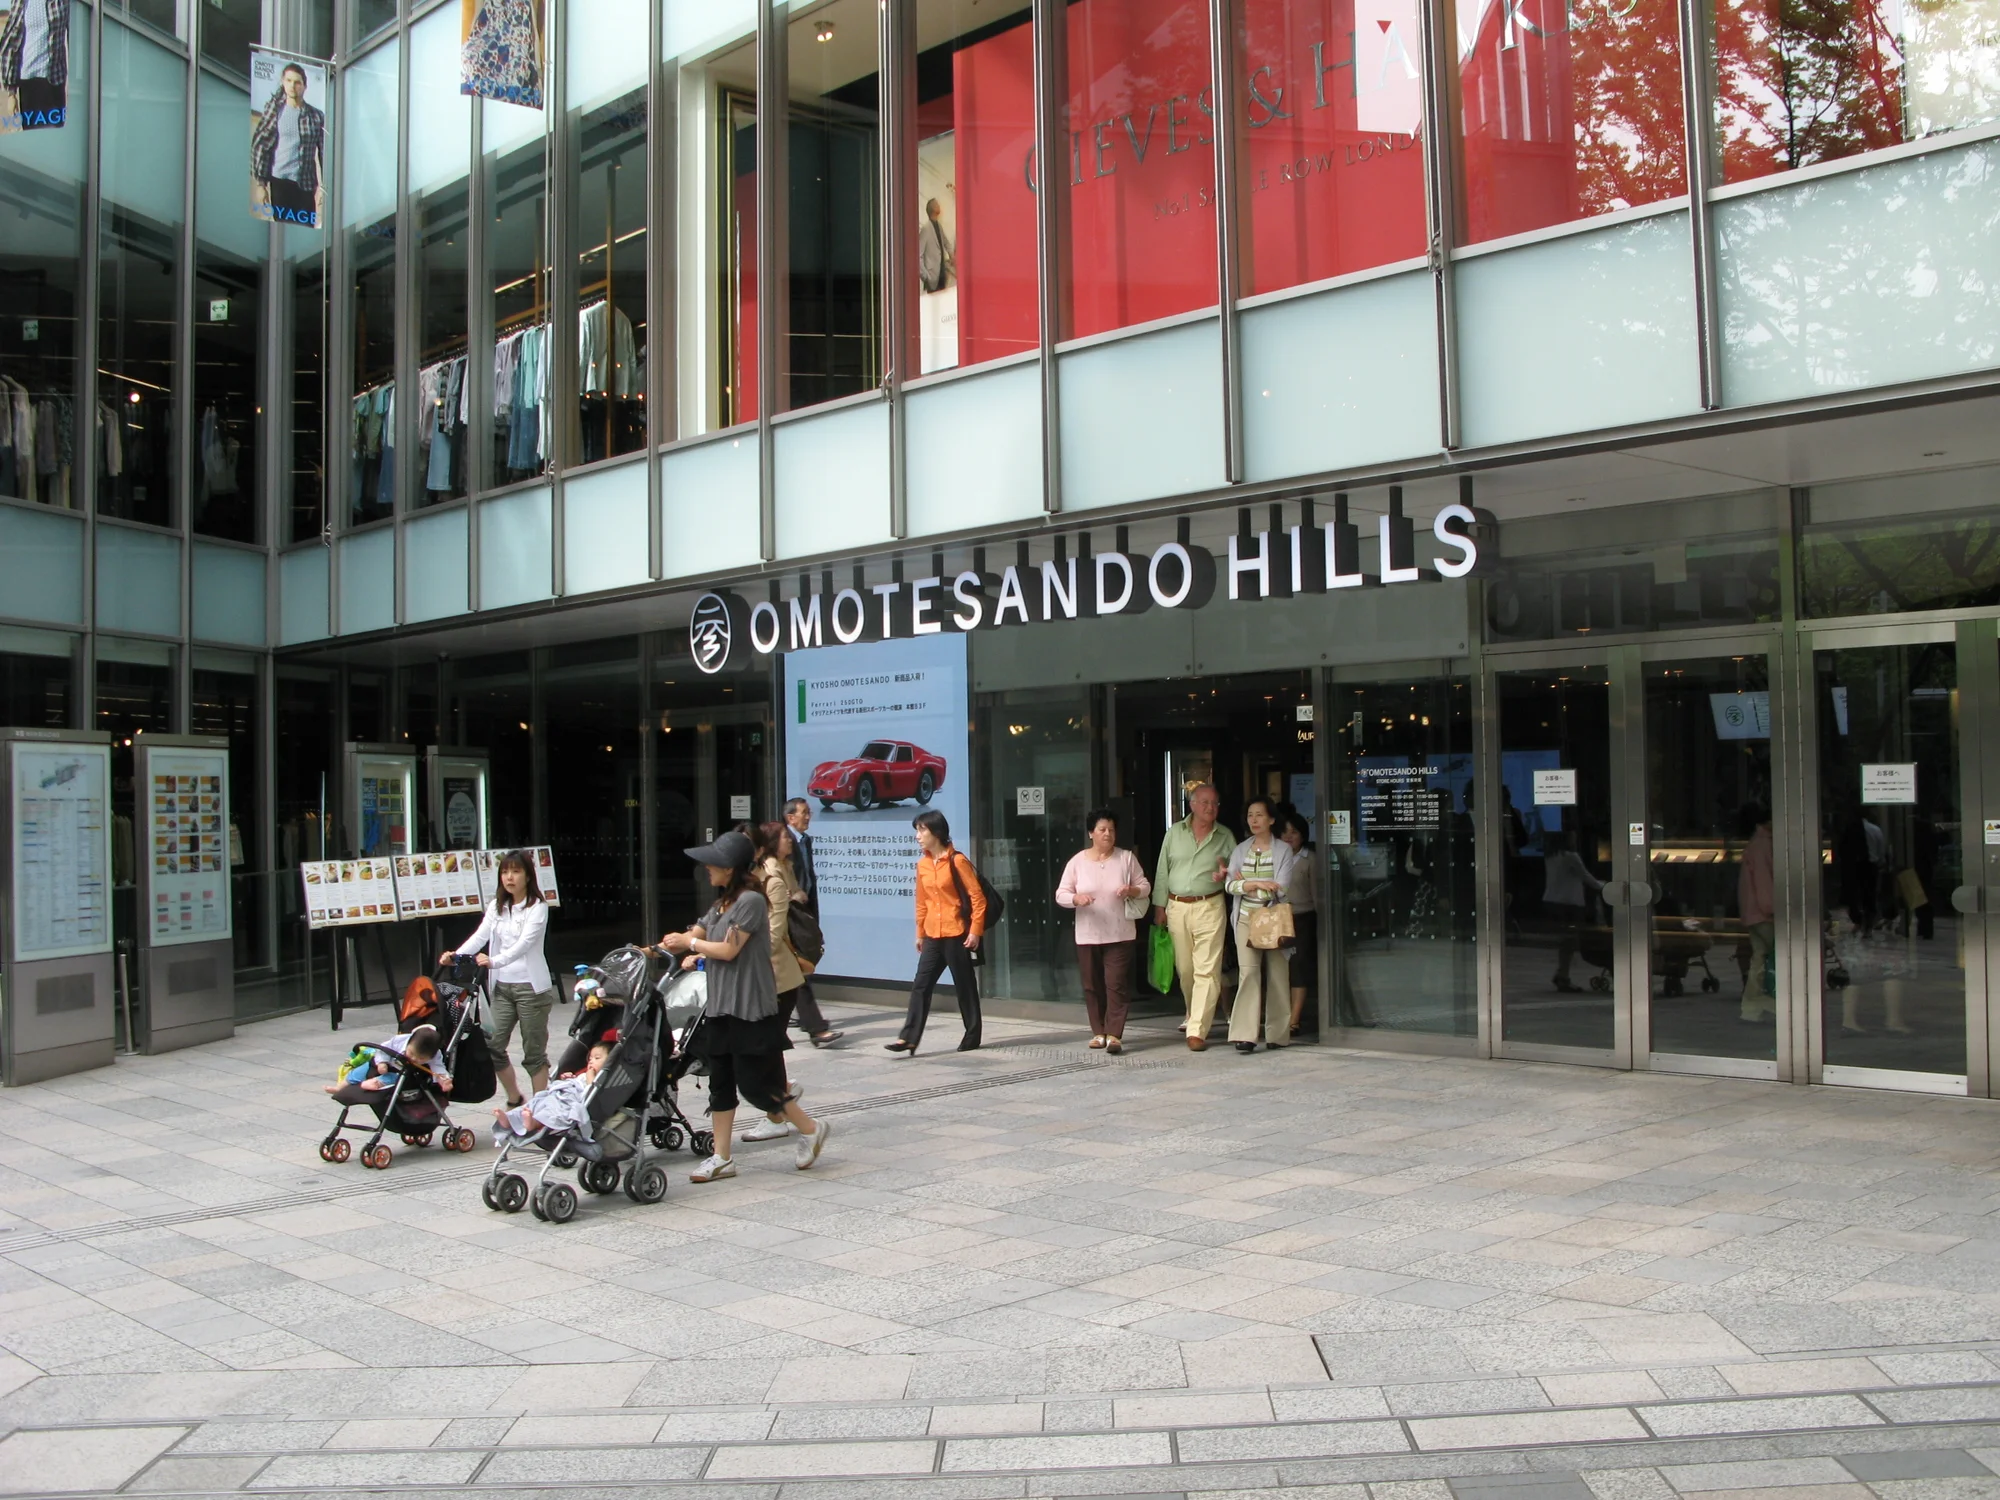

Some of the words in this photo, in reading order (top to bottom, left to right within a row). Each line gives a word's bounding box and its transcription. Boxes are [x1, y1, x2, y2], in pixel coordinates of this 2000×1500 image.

[1248, 66, 1294, 128] &
[1279, 149, 1334, 184] ROW
[1345, 126, 1424, 167] LOND
[252, 203, 319, 225] VOYAGE
[750, 542, 1192, 654] OMOTESANDO
[1228, 504, 1477, 600] HILLS
[811, 680, 839, 690] KYOSHO
[840, 675, 890, 688] OMOTESANDO
[811, 701, 836, 709] Ferrari
[840, 698, 864, 706] 250GTO
[1368, 767, 1418, 777] OMOTESANDO
[1418, 766, 1438, 776] HILLS
[818, 886, 842, 895] YOSHO
